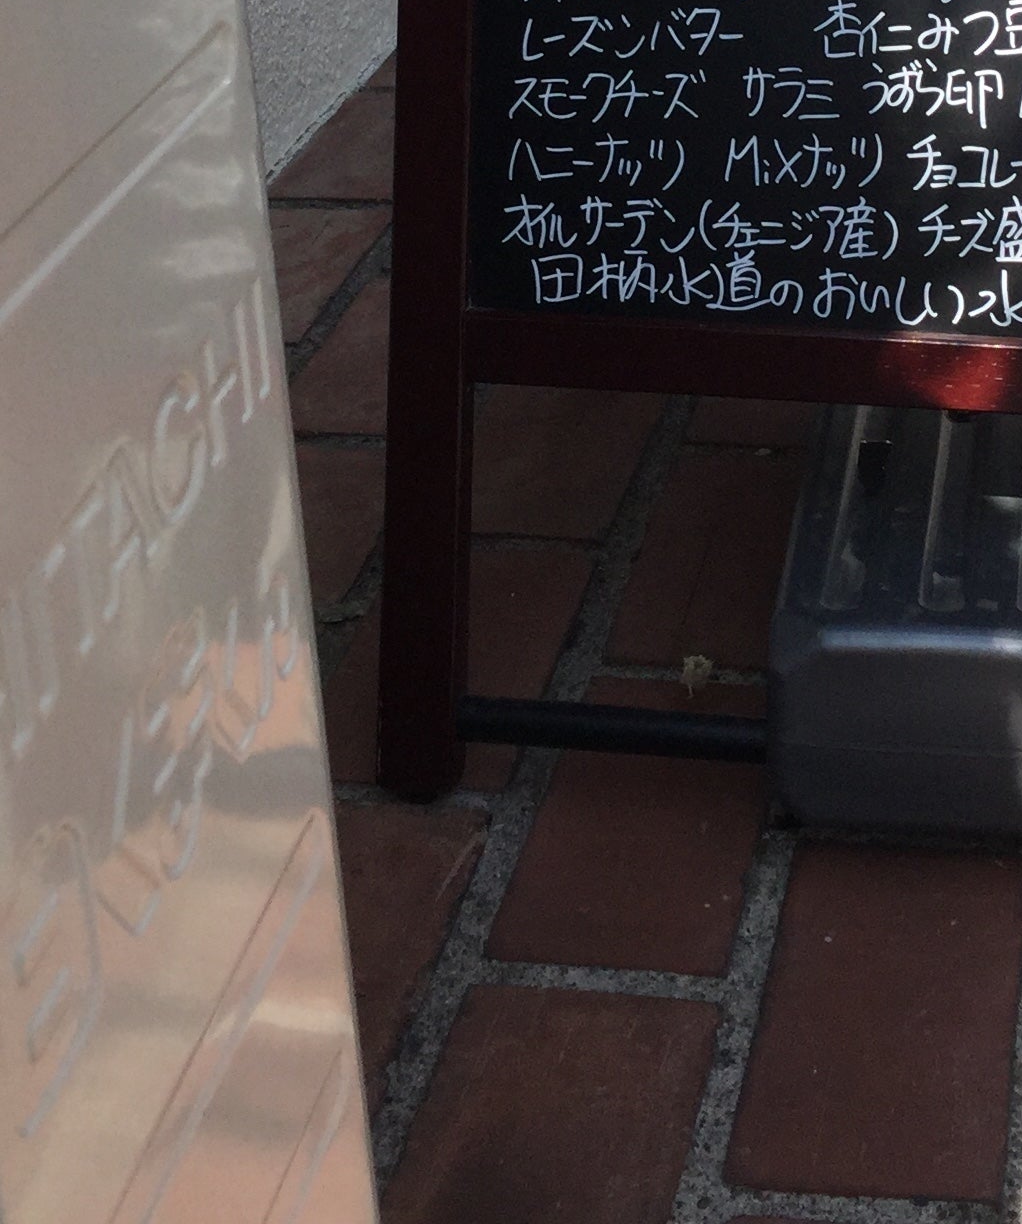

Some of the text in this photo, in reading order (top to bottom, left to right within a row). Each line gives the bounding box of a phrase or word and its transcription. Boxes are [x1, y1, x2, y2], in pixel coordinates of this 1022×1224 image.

[522, 7, 744, 61] レーズンバター
[742, 65, 841, 120] サラミ
[507, 132, 686, 191] ハニーナッツ
